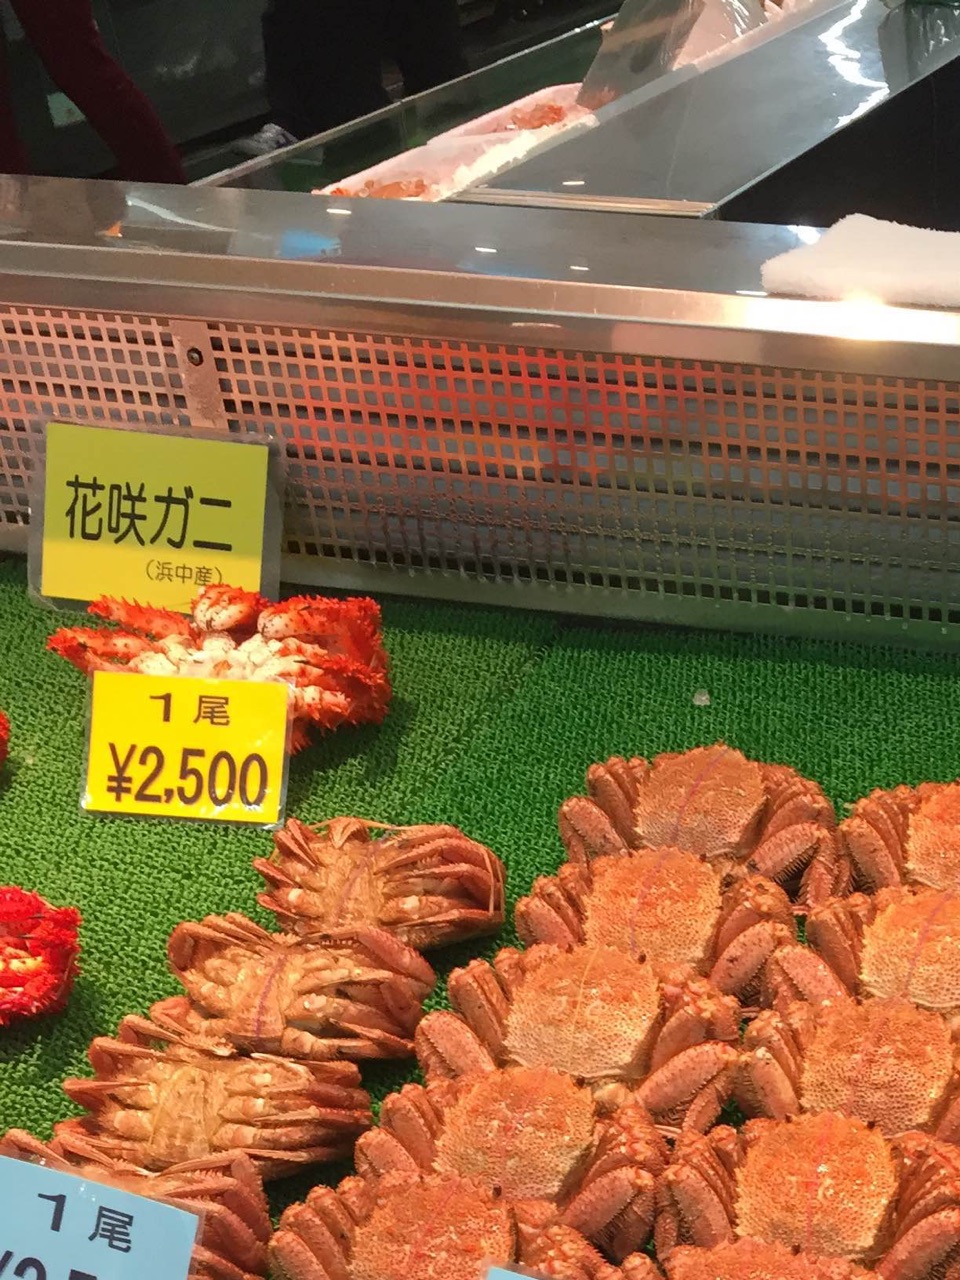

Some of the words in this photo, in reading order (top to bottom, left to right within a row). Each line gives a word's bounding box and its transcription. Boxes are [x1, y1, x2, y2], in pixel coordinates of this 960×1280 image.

[65, 474, 232, 551] 花咲ガニ
[106, 742, 269, 807] ¥2,500
